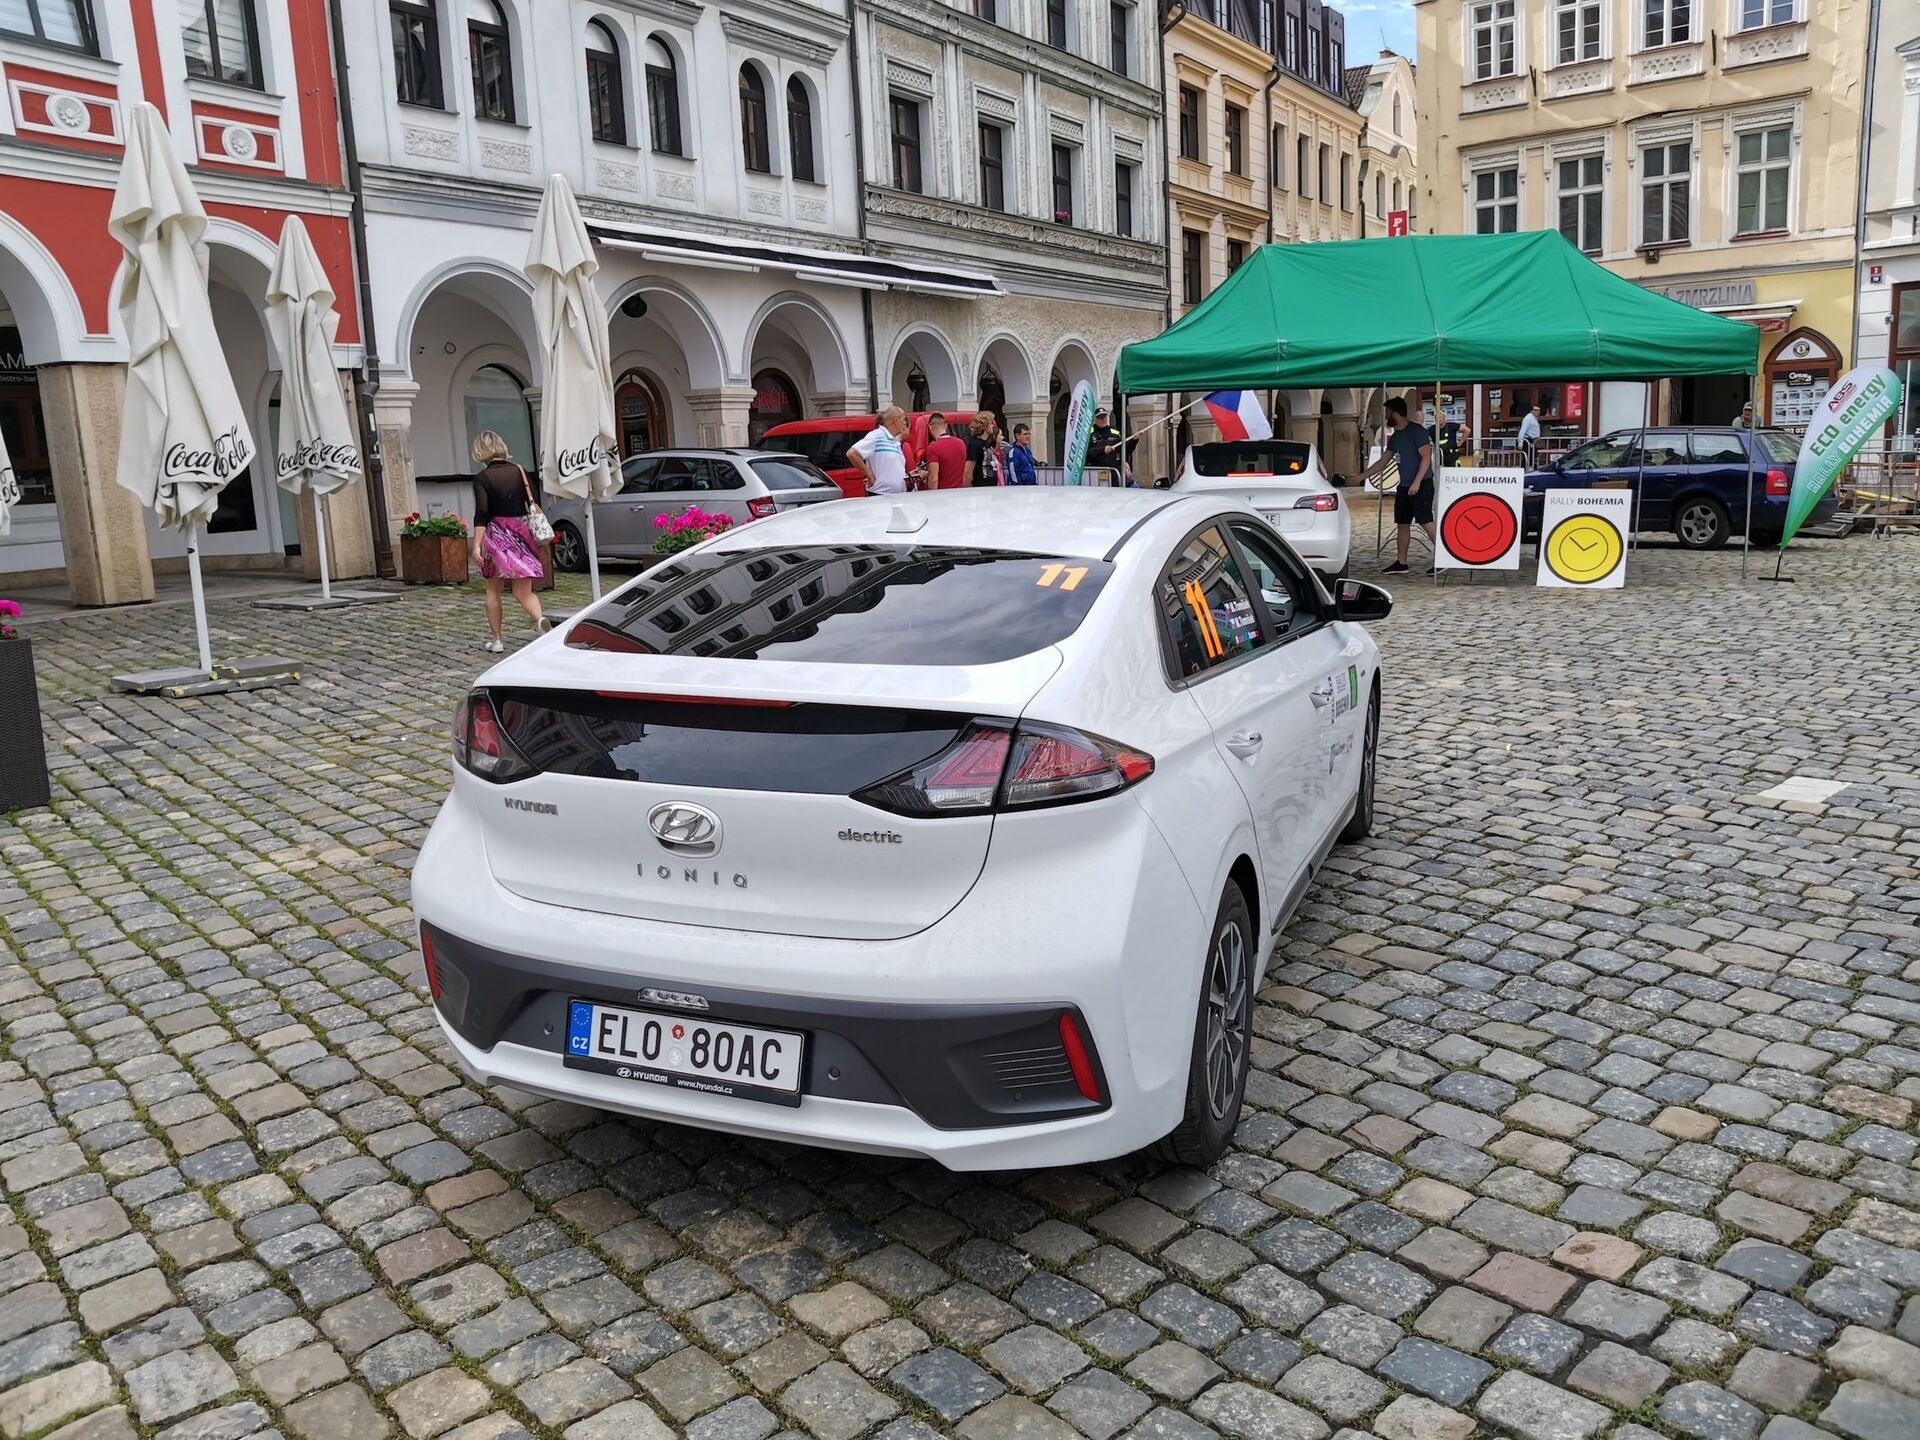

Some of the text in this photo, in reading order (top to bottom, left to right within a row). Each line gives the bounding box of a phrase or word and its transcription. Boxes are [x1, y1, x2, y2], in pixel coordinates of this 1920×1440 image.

[1827, 381, 1853, 412] ABS
[1809, 373, 1887, 457] ECO energy
[1806, 395, 1895, 494] RALLY BOHEMIA
[1445, 475, 1518, 485] RALLY BOHEMIA
[1550, 497, 1625, 506] RALLY BOHEMIA
[1036, 563, 1089, 591] 11
[1185, 579, 1224, 659] 11
[504, 797, 558, 816] HYUNDAI
[837, 827, 903, 844] electric
[637, 862, 748, 888] IONIQ
[572, 1036, 589, 1050] CZ
[633, 1071, 733, 1095] HYUNDAI www.hyundai.cz
